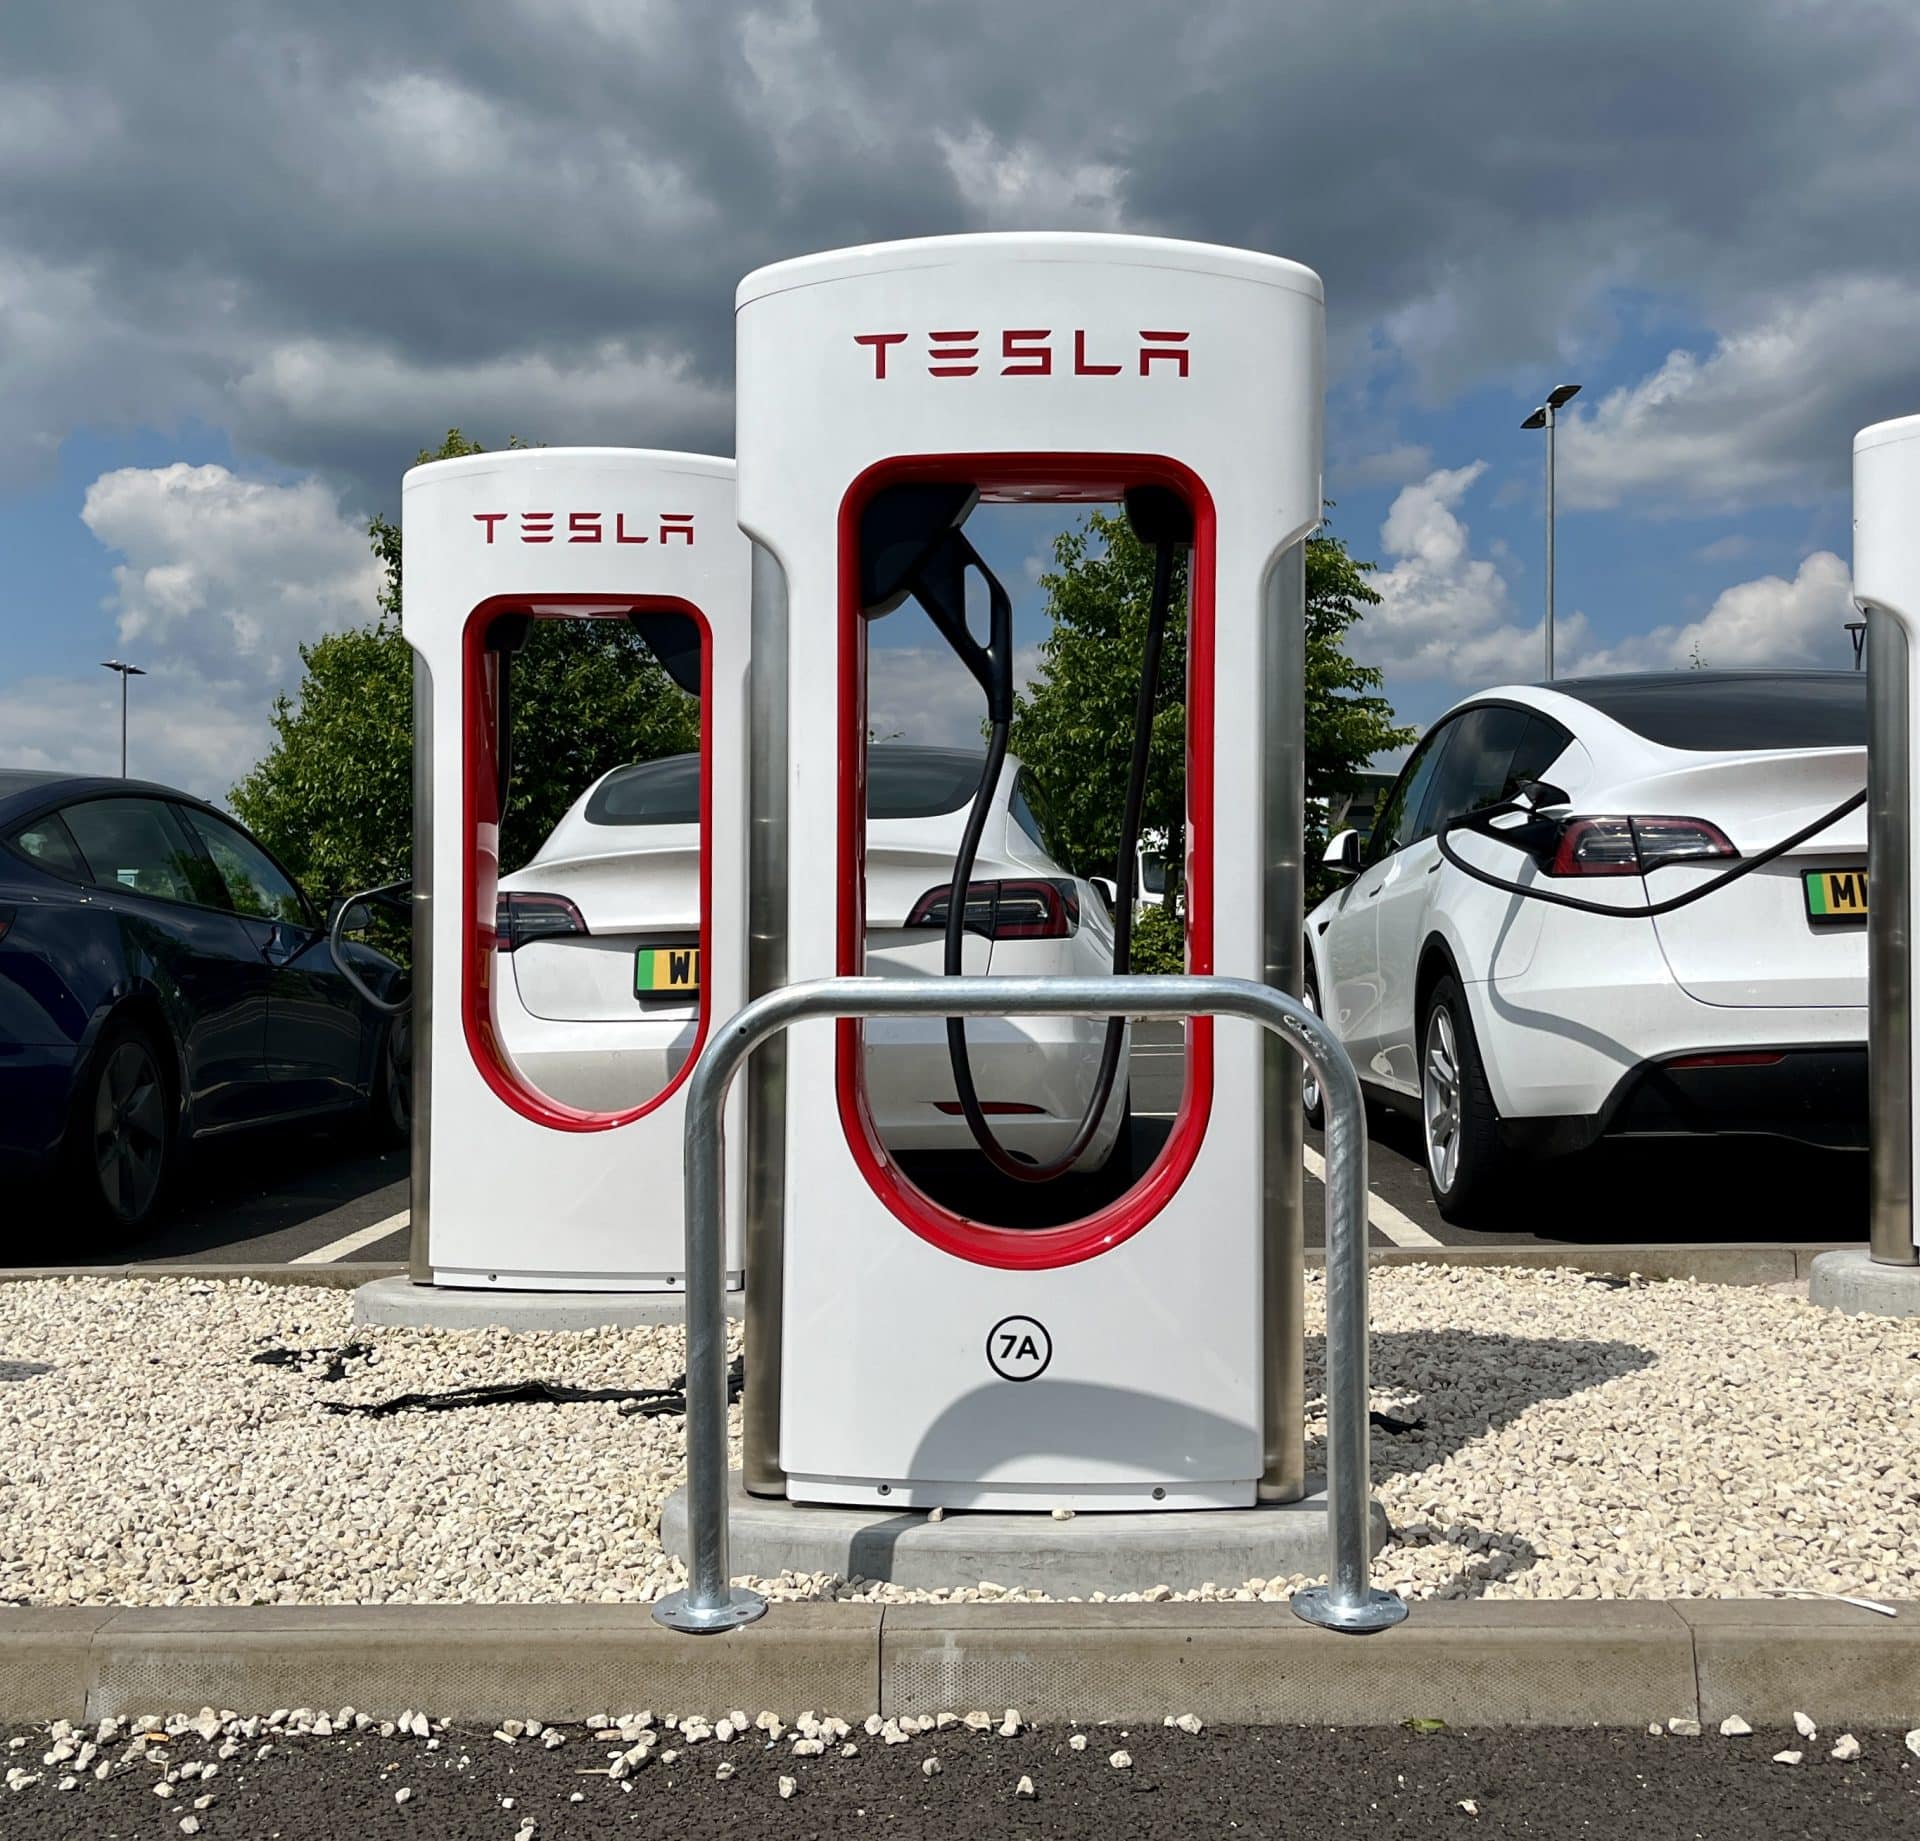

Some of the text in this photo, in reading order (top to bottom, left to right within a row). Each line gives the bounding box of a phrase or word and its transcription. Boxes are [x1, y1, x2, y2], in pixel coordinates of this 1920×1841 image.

[853, 329, 1191, 380] TESLA
[472, 512, 695, 545] TESLA
[669, 951, 701, 985] W
[999, 1334, 1040, 1361] 7A
